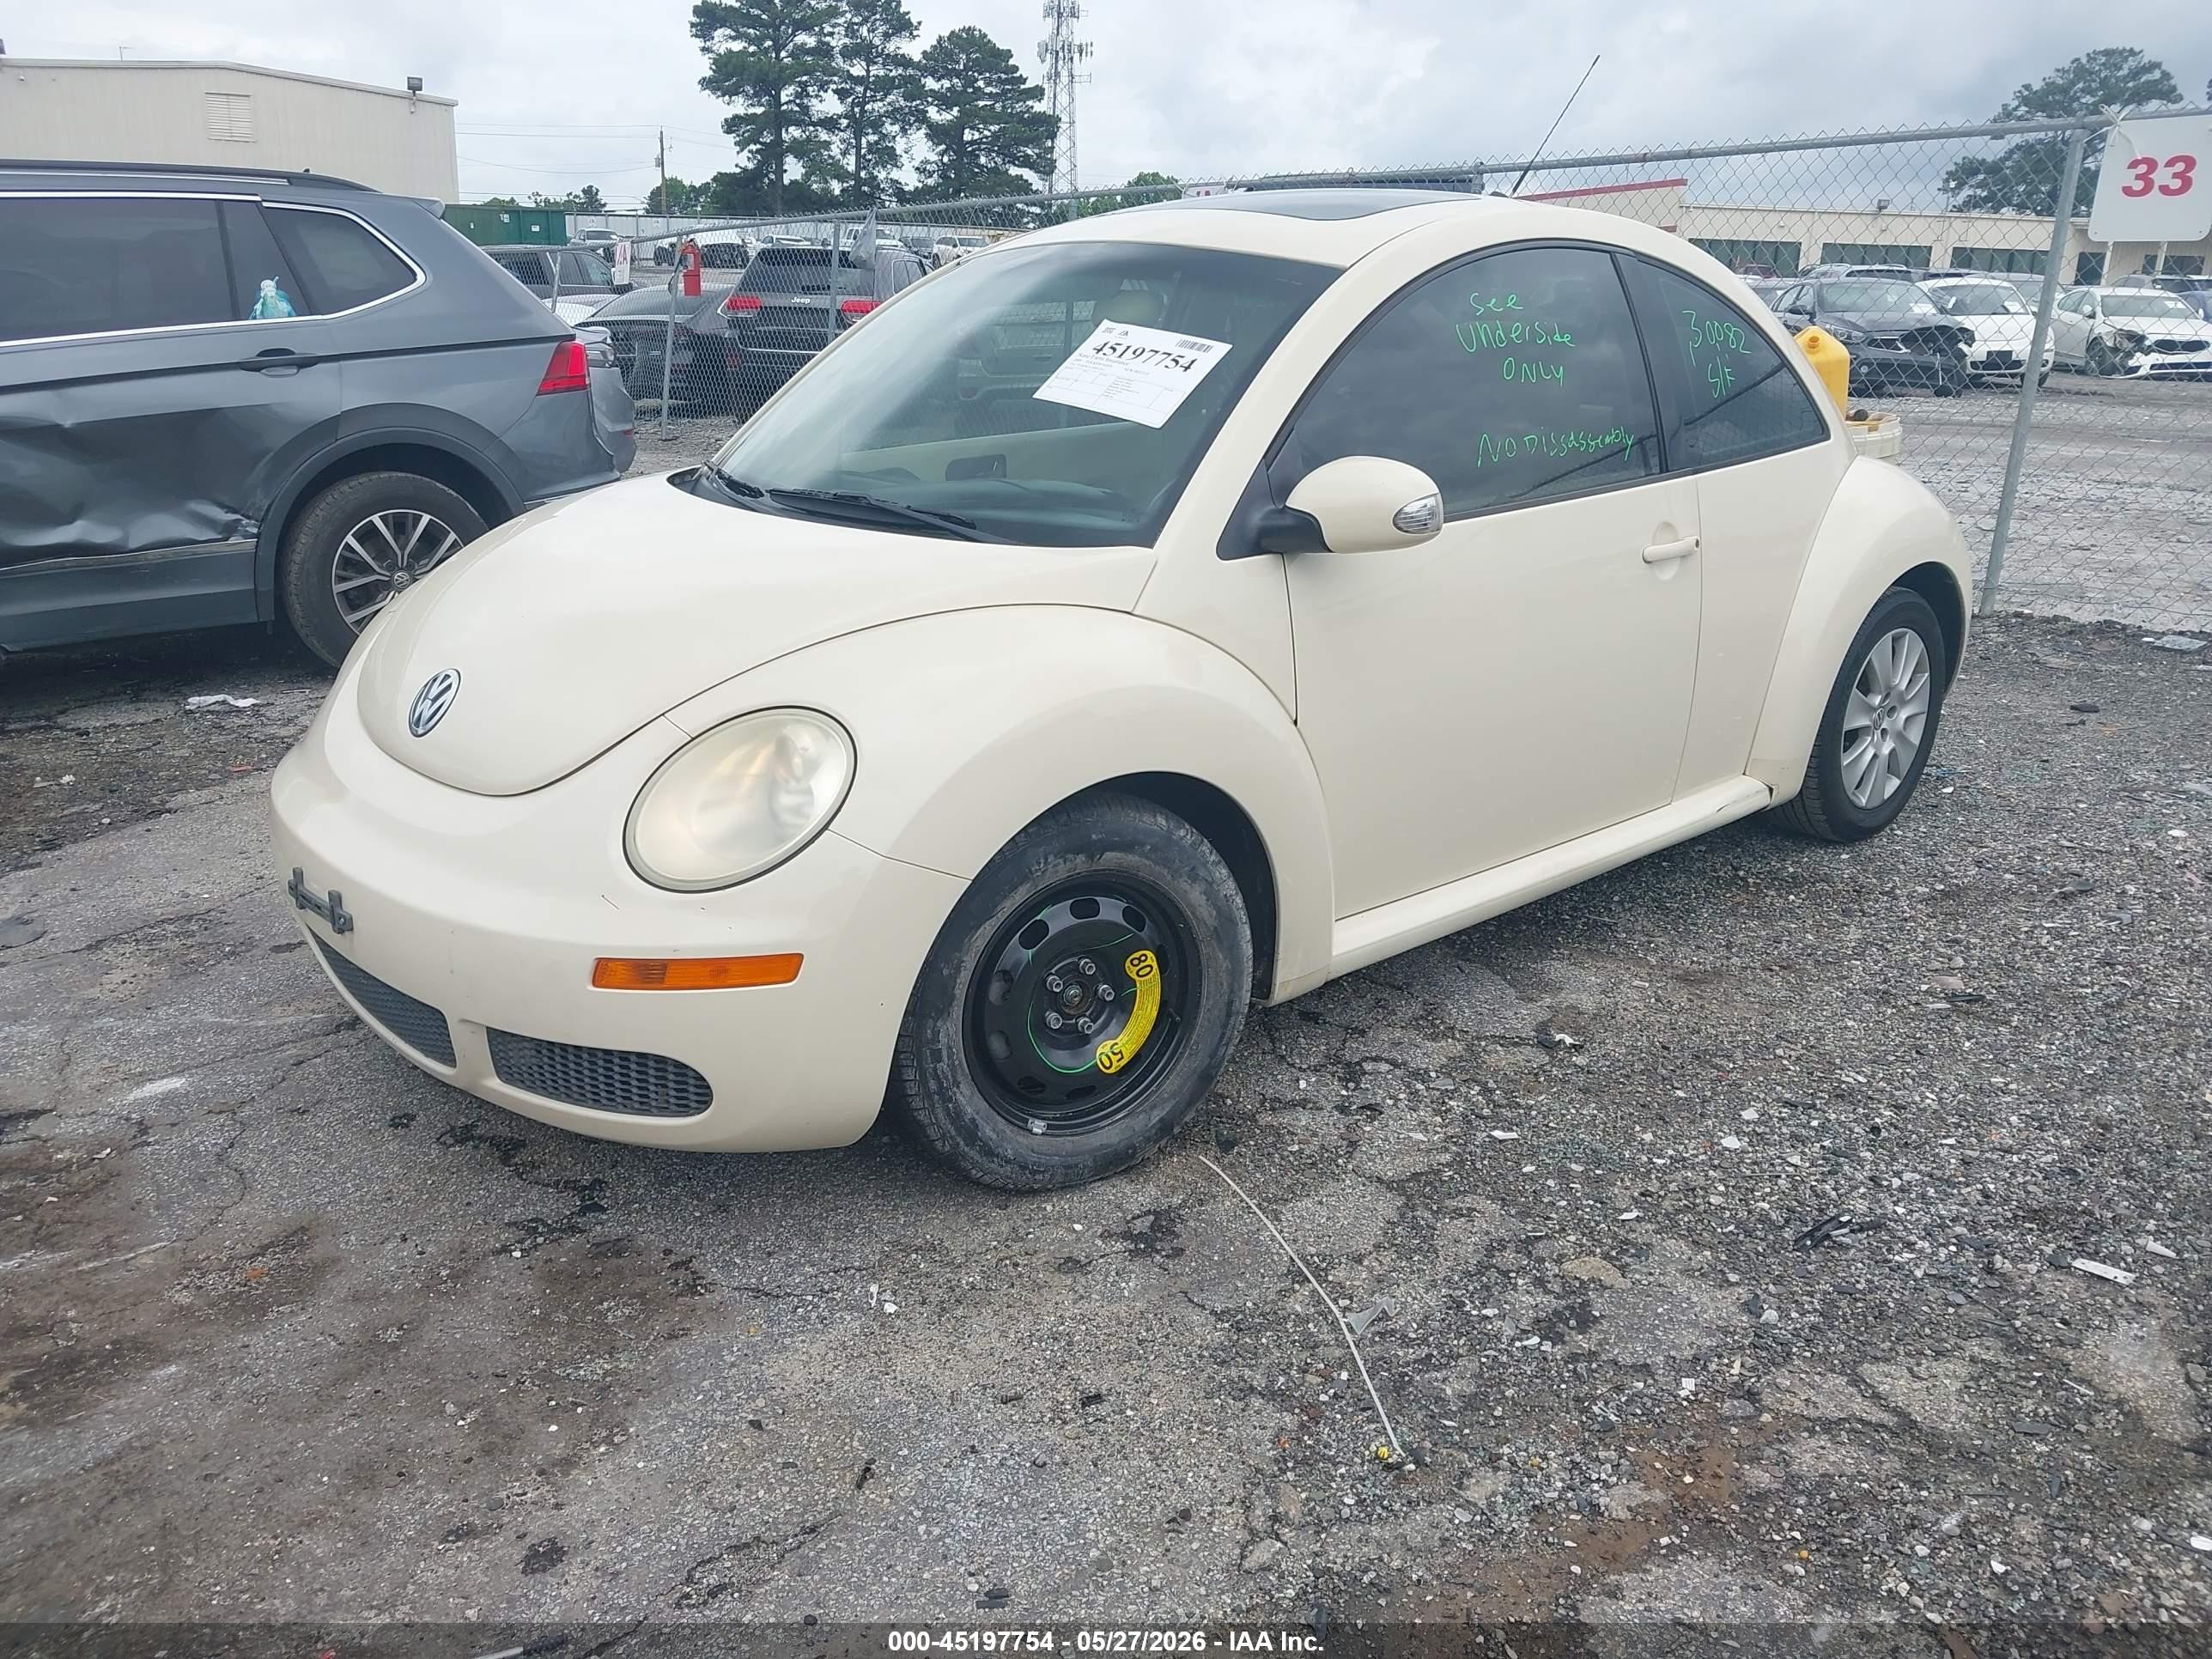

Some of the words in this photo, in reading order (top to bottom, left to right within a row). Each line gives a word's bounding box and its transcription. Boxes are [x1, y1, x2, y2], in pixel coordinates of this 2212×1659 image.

[2121, 155, 2197, 198] 33
[1092, 340, 1198, 373] 45197754
[1129, 953, 1154, 978] 80
[1098, 1042, 1125, 1071] 50
